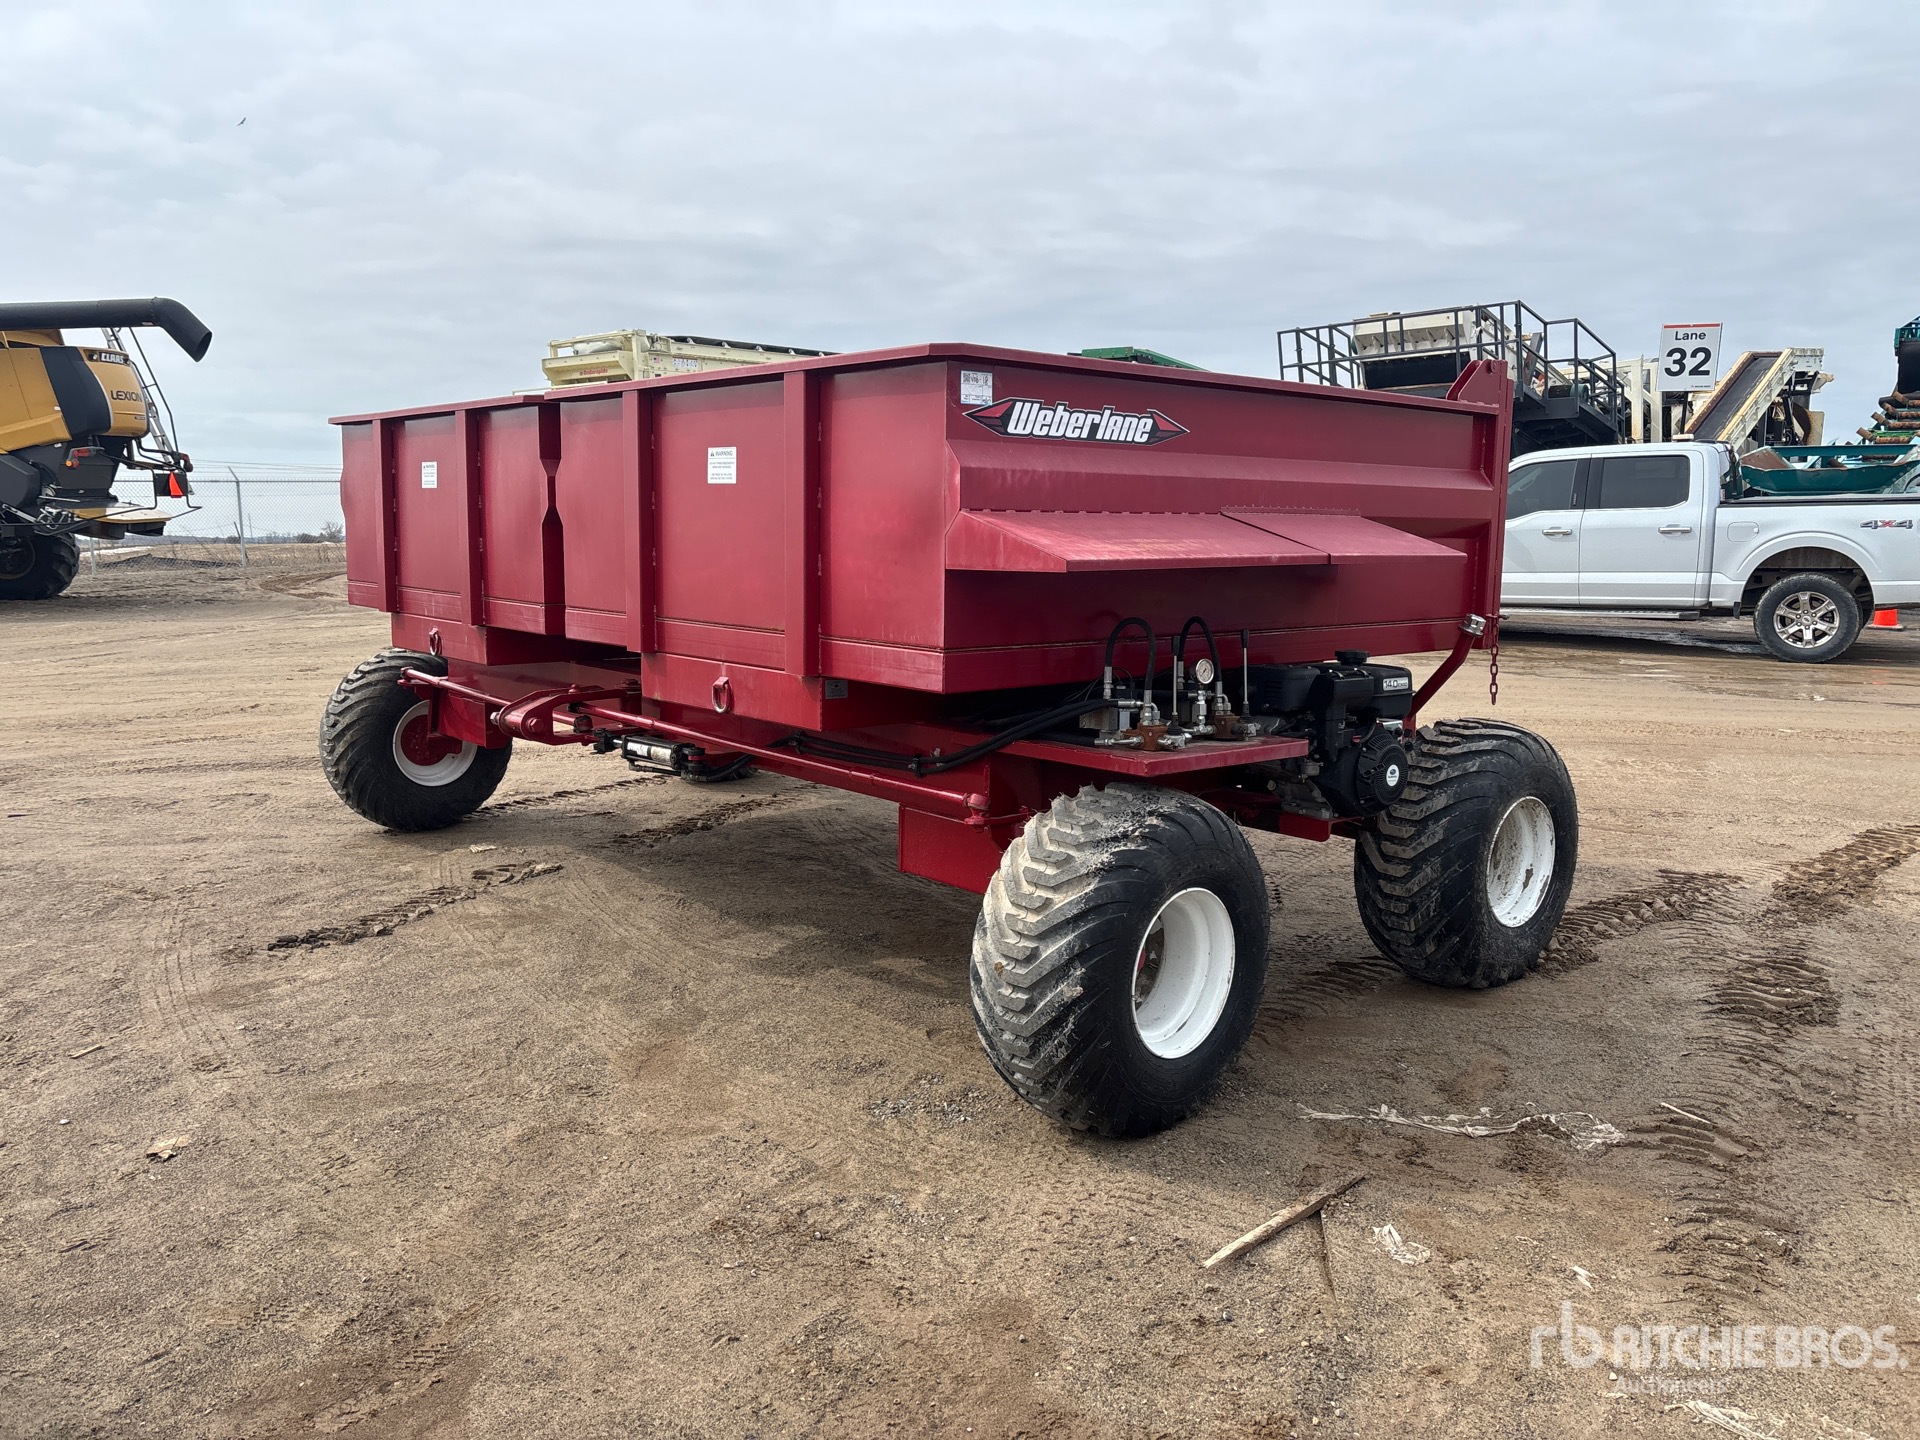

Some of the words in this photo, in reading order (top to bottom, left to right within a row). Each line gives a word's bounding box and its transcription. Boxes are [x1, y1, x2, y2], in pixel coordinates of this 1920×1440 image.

[1674, 330, 1707, 341] Lane
[101, 352, 124, 364] CLAAS
[1664, 346, 1712, 377] 32
[110, 389, 143, 403] LEXION
[1006, 400, 1154, 443] Weberlane
